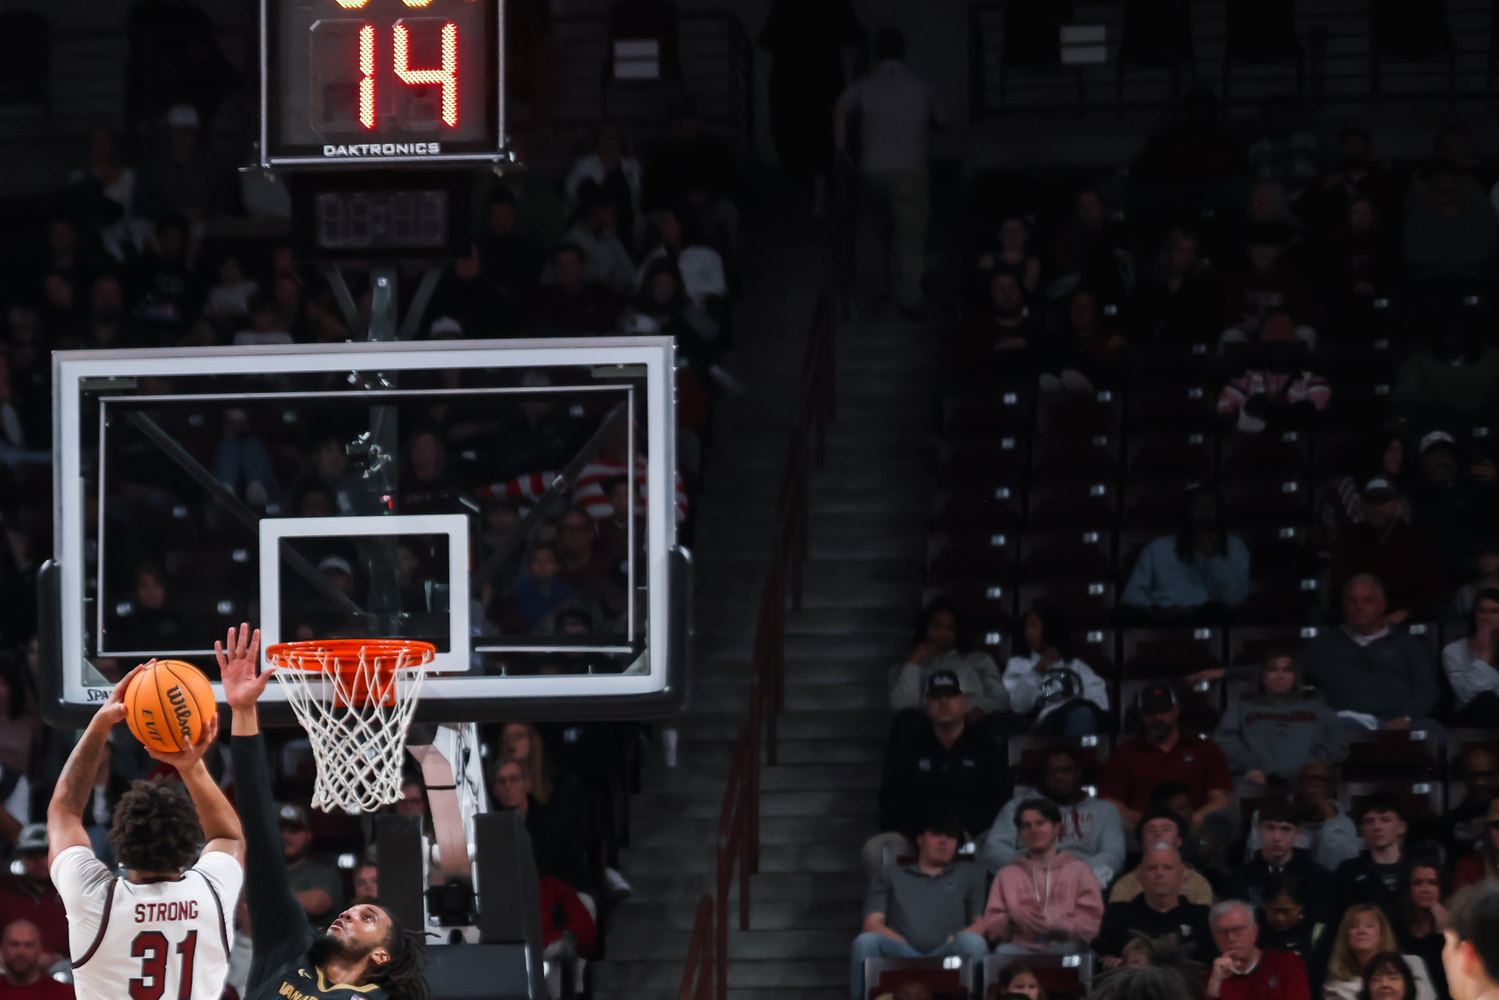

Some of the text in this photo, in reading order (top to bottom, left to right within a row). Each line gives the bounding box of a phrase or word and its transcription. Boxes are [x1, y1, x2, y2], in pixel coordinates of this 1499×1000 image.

[359, 22, 457, 129] 14
[323, 142, 441, 157] DAKTRONICS
[134, 900, 199, 924] STRONG
